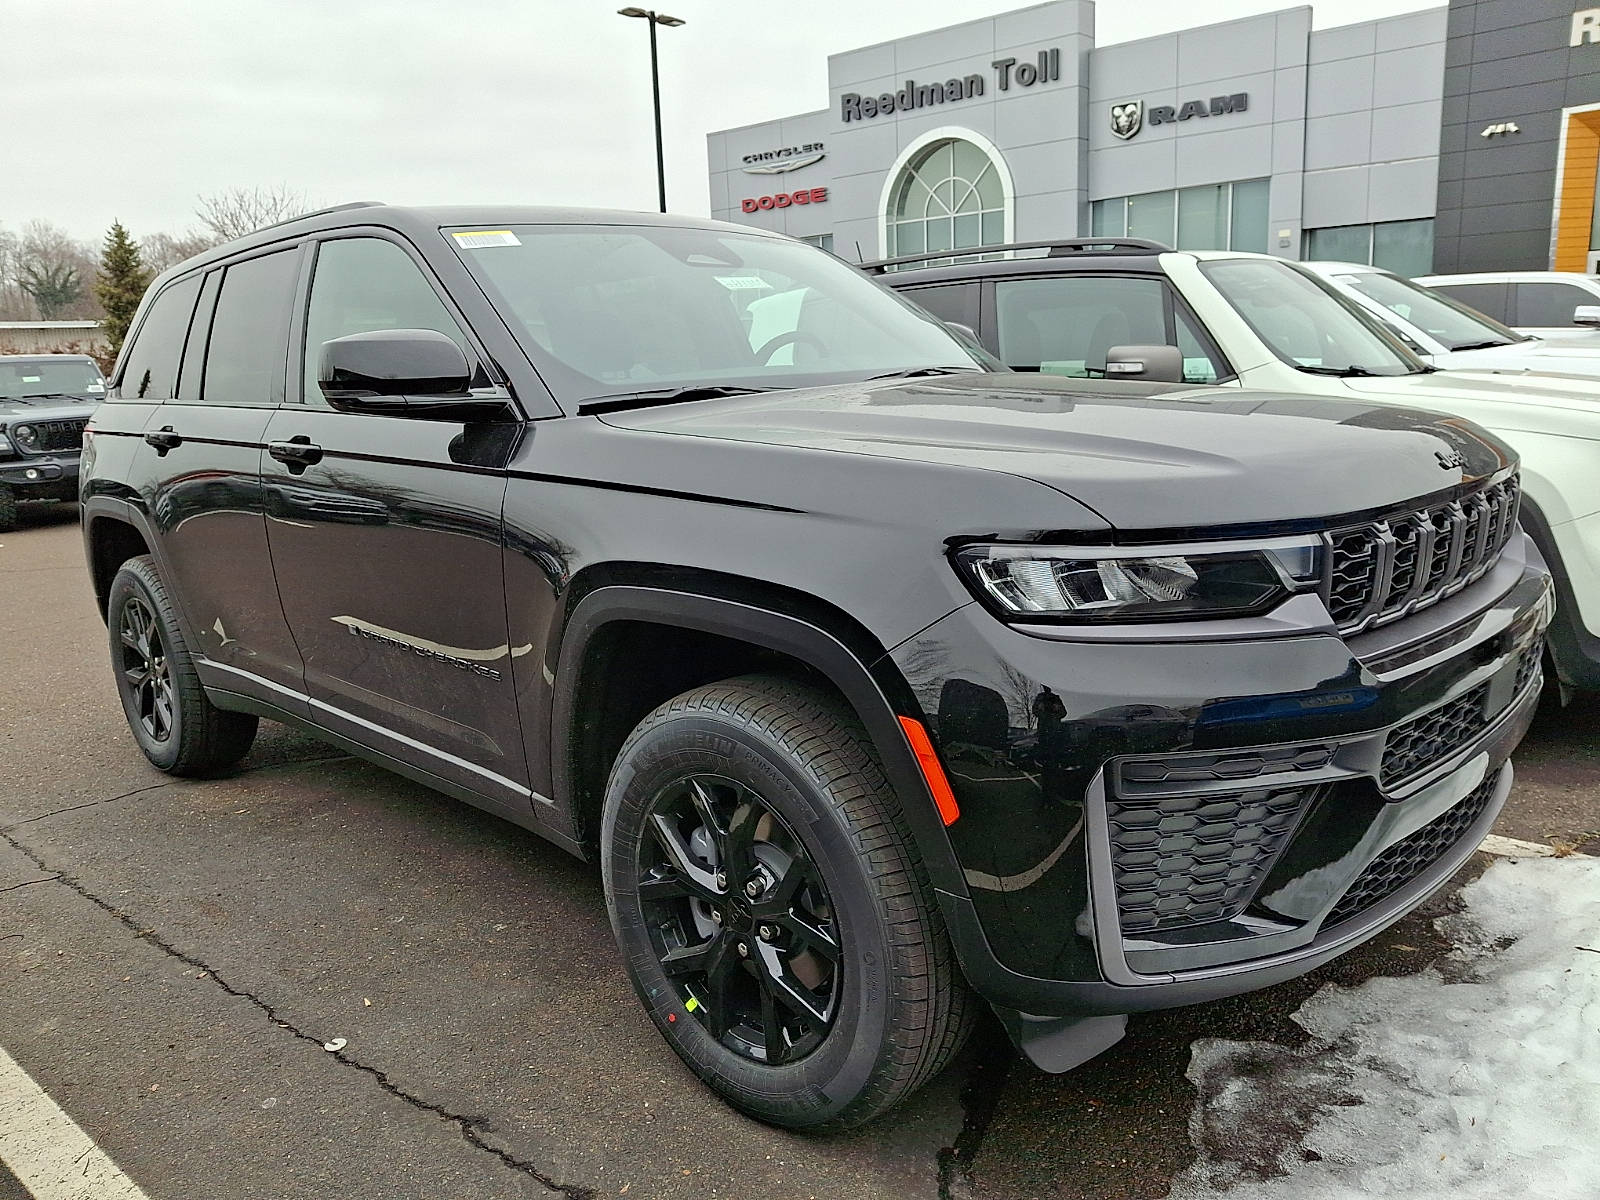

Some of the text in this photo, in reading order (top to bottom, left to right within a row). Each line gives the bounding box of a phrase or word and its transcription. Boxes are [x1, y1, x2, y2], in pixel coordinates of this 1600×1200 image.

[841, 48, 1060, 122] Reedman Toll
[1148, 92, 1248, 126] RAM
[742, 142, 824, 163] CHRYSLER
[742, 187, 827, 213] DODGE
[660, 731, 792, 793] CHELIN PRIMACY
